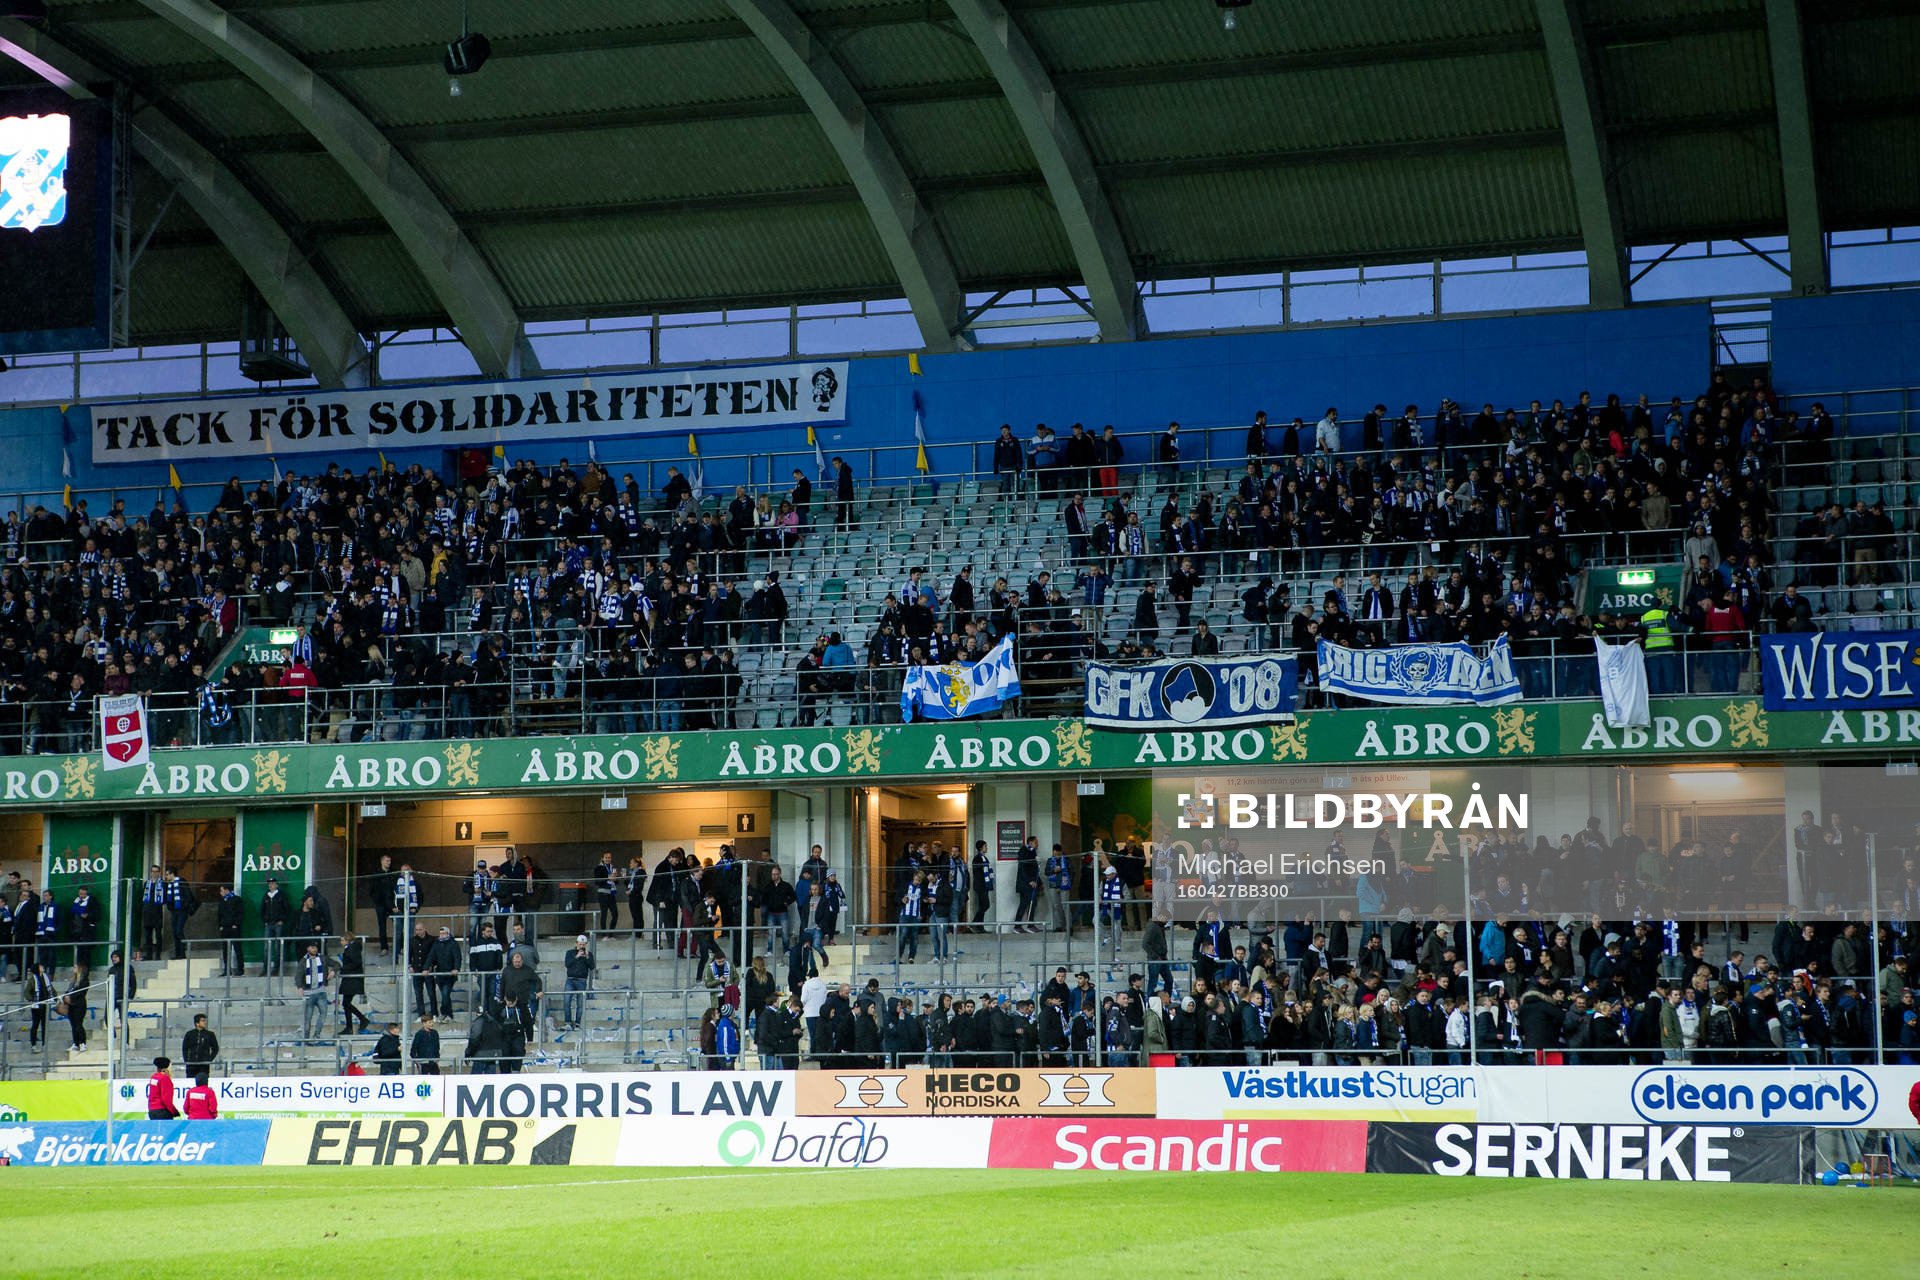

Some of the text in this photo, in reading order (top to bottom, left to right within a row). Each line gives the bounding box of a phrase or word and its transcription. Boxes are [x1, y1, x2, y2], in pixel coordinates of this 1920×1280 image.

[97, 376, 801, 450] TACK FÖR SOLIDARITETEN
[247, 647, 286, 664] ÅBR
[1770, 631, 1914, 700] WISE
[1087, 667, 1156, 718] GFK
[925, 733, 1051, 769] ÅBRO
[1354, 719, 1491, 757] ÅBRO
[325, 754, 442, 788] ÅBRO
[521, 748, 640, 783] ÅBRO
[720, 740, 842, 776] ÅBRO
[135, 761, 250, 795] ÅBRO
[1084, 784, 1097, 795] 13
[1330, 777, 1345, 788] 12
[50, 856, 109, 875] ÅBRO
[243, 853, 302, 873] ÅBRO
[221, 1081, 292, 1099] Karlsen
[300, 1081, 371, 1104] Sverige
[377, 1082, 405, 1099] AB
[456, 1080, 783, 1117] MORRIS LAW
[925, 1073, 1021, 1093] HECO
[1642, 1074, 1867, 1118] clean park
[926, 1095, 1021, 1108] NORDISKA
[34, 1132, 216, 1167] Björnkläder
[771, 1120, 889, 1168] bafab
[1052, 1123, 1282, 1173] Scandic
